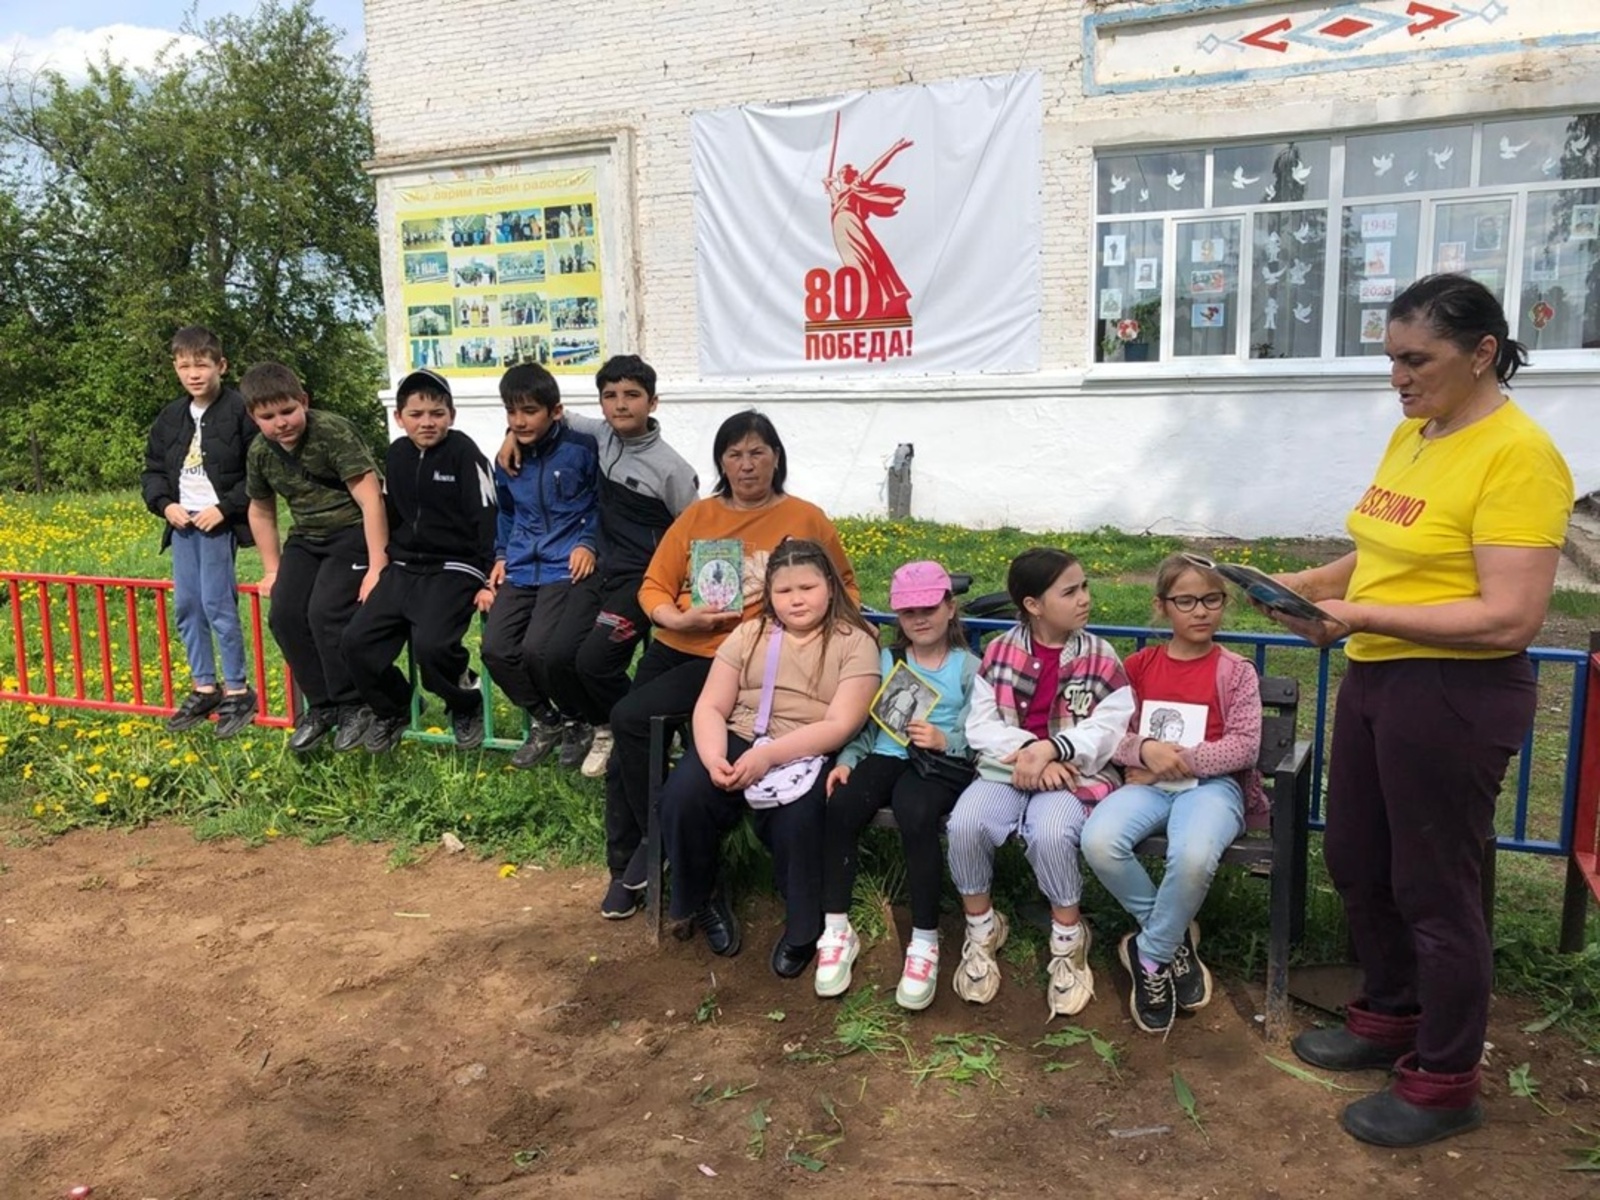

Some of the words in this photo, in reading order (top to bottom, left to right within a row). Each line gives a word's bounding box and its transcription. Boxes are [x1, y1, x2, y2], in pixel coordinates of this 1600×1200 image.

[1363, 219, 1396, 233] 1945
[804, 266, 862, 322] 80
[1362, 286, 1393, 298] 2025
[805, 329, 913, 363] ПОБЕДА!
